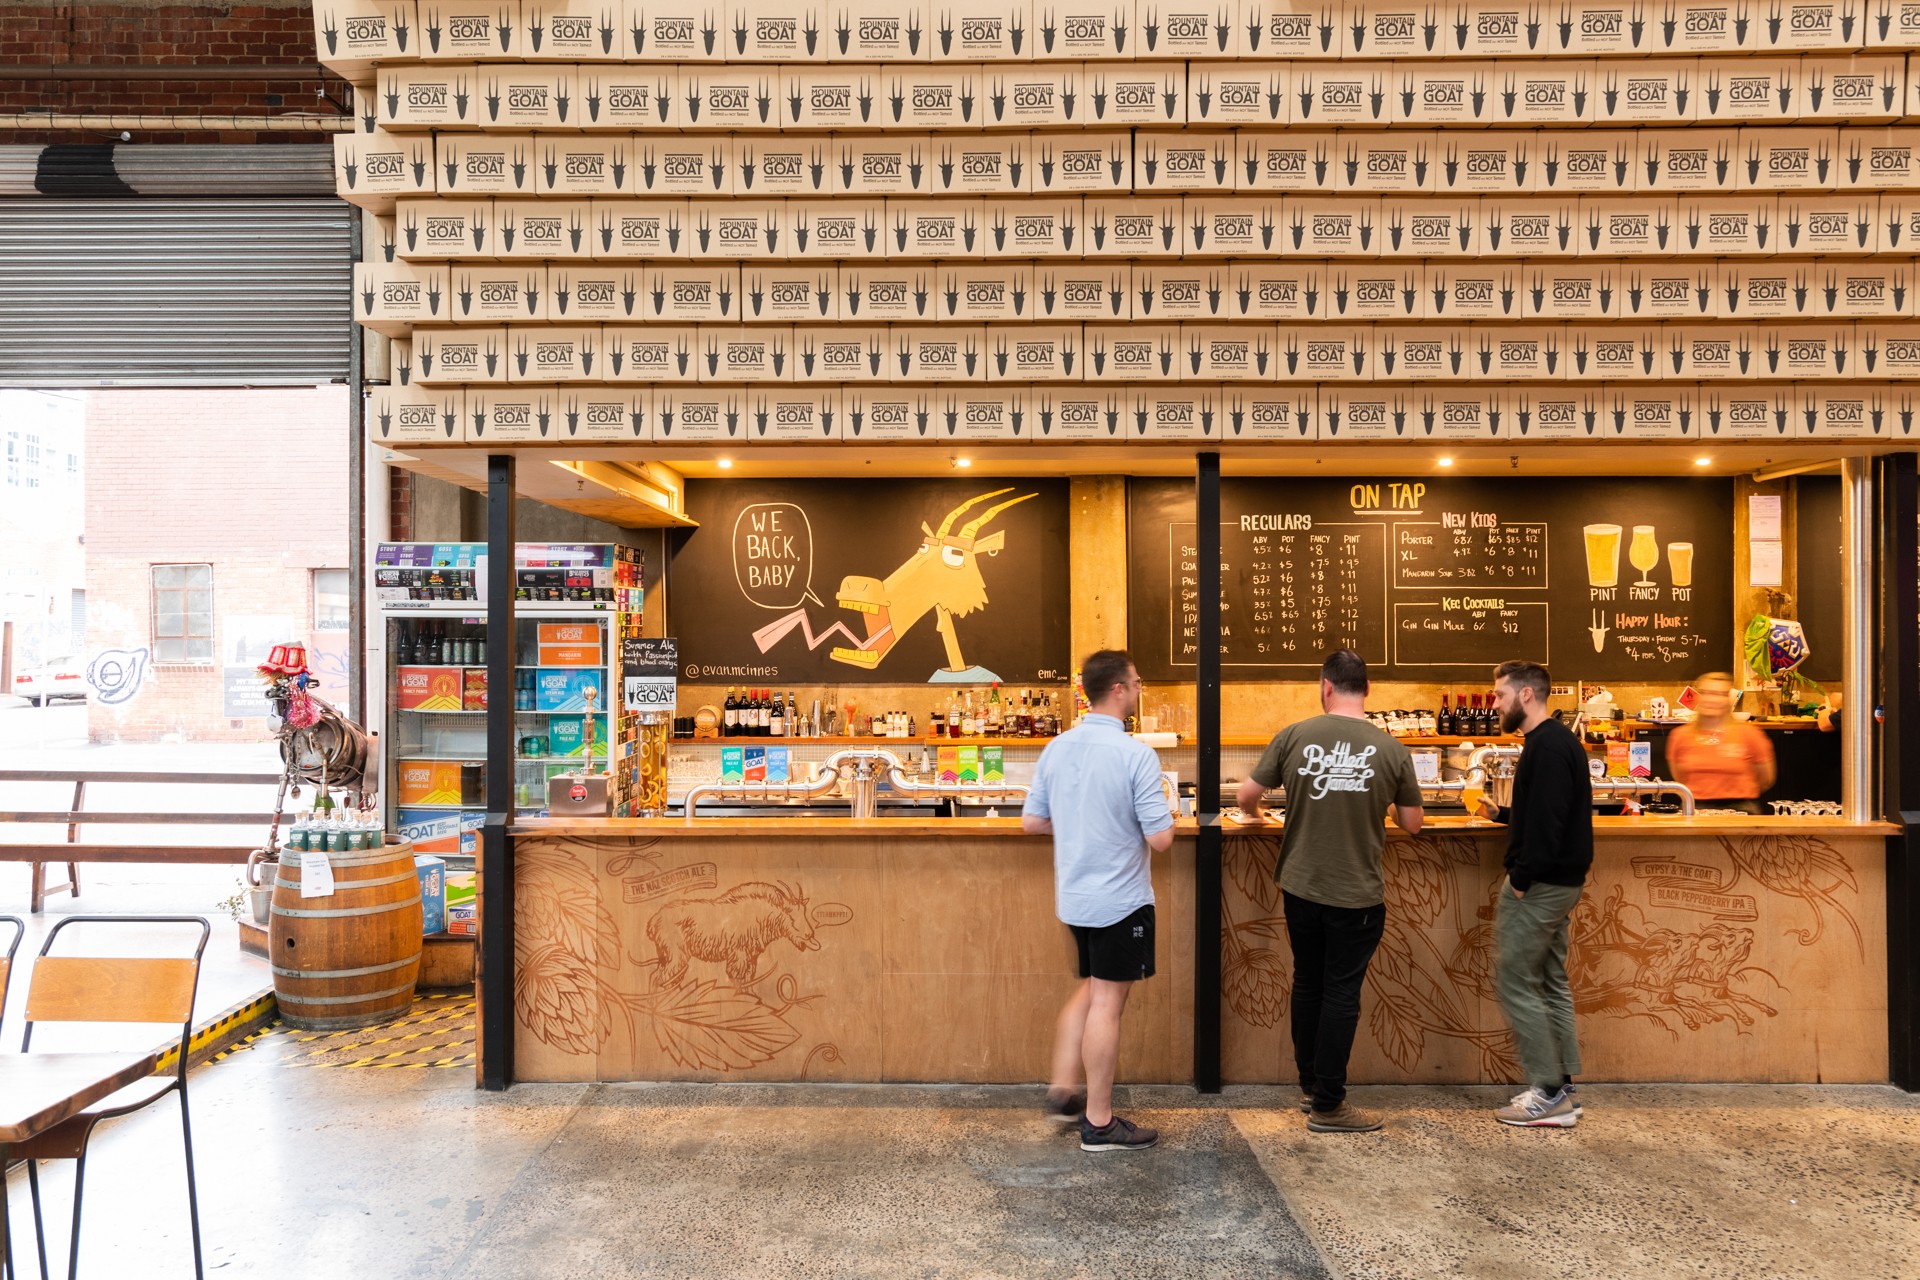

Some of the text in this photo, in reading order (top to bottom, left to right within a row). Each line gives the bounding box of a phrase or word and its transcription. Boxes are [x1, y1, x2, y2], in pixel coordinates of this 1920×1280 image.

[1686, 12, 1726, 20] MOUNTAIN
[346, 20, 386, 28] MOUNTAIN
[1686, 19, 1726, 32] GOAT
[346, 27, 386, 40] GOAT
[1065, 26, 1104, 38] GOAT
[710, 95, 749, 108] GOAT
[1424, 91, 1463, 103] GOAT
[366, 162, 404, 174] GOAT
[1568, 160, 1606, 172] GOAT
[1015, 225, 1053, 237] GOAT
[1810, 222, 1848, 234] GOAT
[578, 290, 616, 302] GOAT
[1260, 289, 1298, 301] GOAT
[920, 352, 957, 364] GOAT
[1693, 349, 1731, 361] GOAT
[1157, 411, 1193, 422] GOAT
[1350, 483, 1426, 509] ON TAP
[752, 511, 783, 532] WE
[1241, 514, 1312, 532] REGULARS
[1442, 511, 1497, 528] NEW KIDS
[1253, 536, 1268, 544] ABV
[1310, 535, 1330, 543] FANCY
[1344, 535, 1361, 543] PINT
[1401, 531, 1433, 545] PORTER
[747, 534, 801, 561] BACK,
[1279, 545, 1291, 554] $6
[1310, 545, 1323, 555] $8
[1401, 550, 1418, 561] XL
[1280, 561, 1293, 569] $5
[749, 565, 795, 588] BABY
[1280, 572, 1293, 583] $6
[1311, 571, 1324, 580] $8
[1280, 585, 1293, 597] $6
[1312, 584, 1323, 594] $8
[1590, 587, 1692, 601] PINT FANCY POT
[1280, 599, 1295, 608] $5
[1463, 596, 1504, 610] COCKTAILS
[1282, 623, 1295, 633] $6
[1312, 621, 1325, 632] $8
[1402, 618, 1518, 633] GIN GIN MULE 6% $12
[1616, 613, 1649, 629] HAPPY
[561, 631, 582, 639] GOAT
[1617, 635, 1650, 643] THURSDAY
[1656, 635, 1676, 644] FRIDAY
[624, 640, 674, 651] Summer Ale
[1282, 640, 1296, 650] $6
[1625, 646, 1640, 661] $4
[1657, 645, 1671, 662] $8
[1038, 670, 1057, 679] emc
[637, 690, 675, 703] GOAT
[746, 758, 764, 767] GOAT
[1298, 741, 1376, 775] Bottled
[1308, 769, 1375, 800] Tamed
[468, 820, 486, 828] GOAT
[399, 824, 435, 840] GOAT
[1645, 863, 1713, 880] GYPSY & THE GOAT
[631, 884, 646, 895] THE
[661, 869, 690, 887] SCOTCH
[691, 866, 706, 877] ALE
[1658, 889, 1680, 900] BLACK
[1682, 891, 1731, 908] PEPPERBERRY
[1732, 899, 1745, 909] IPA
